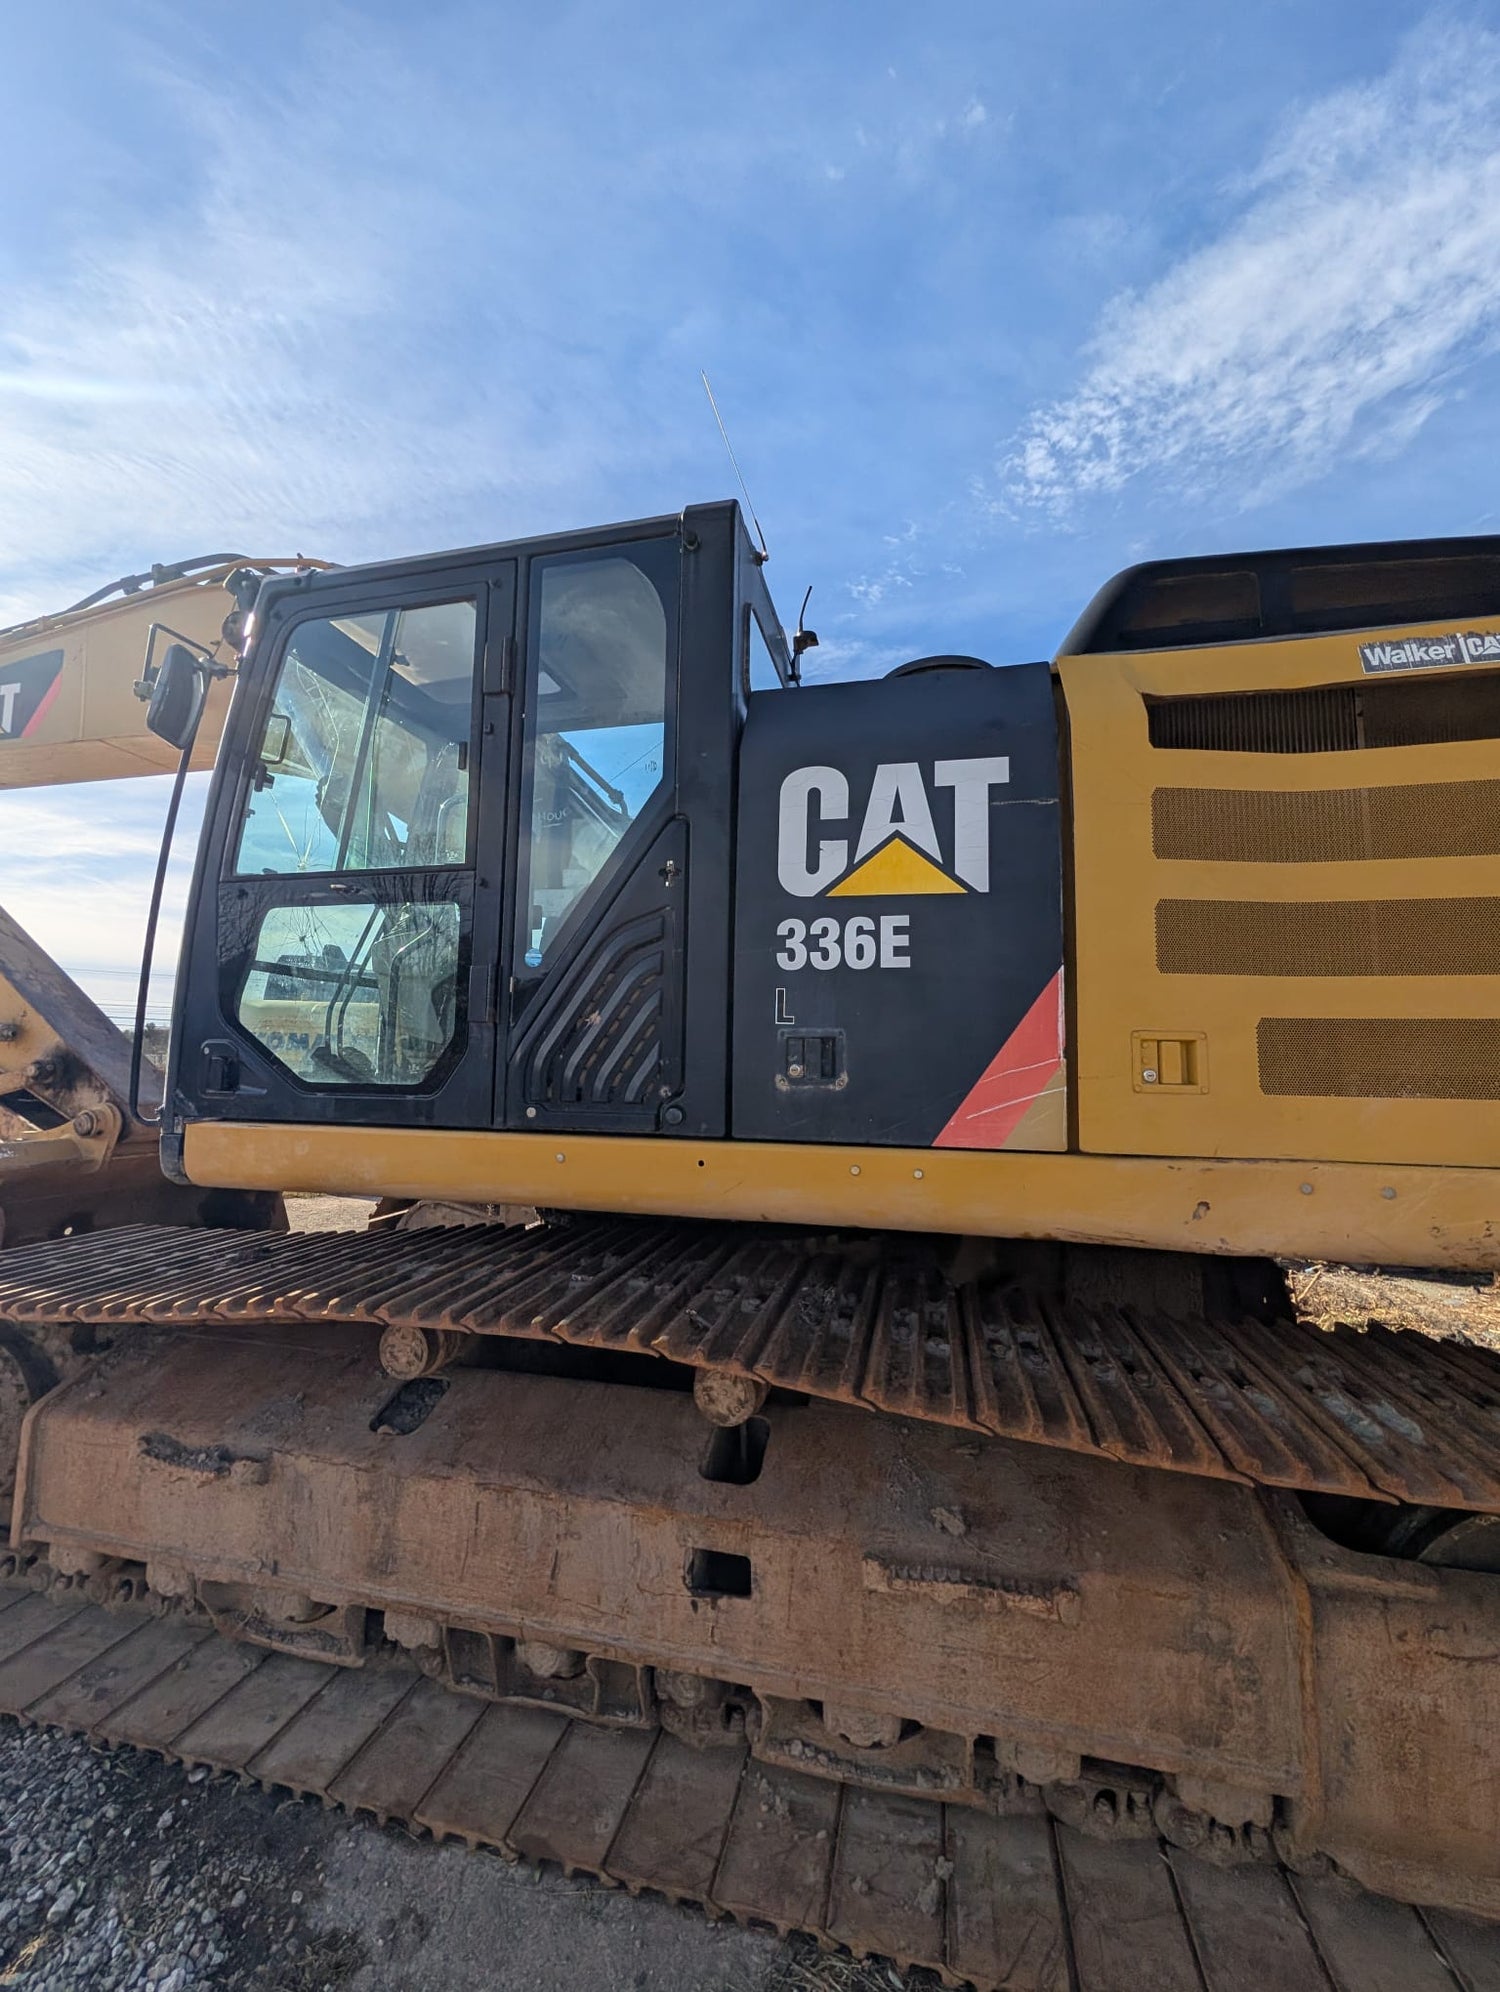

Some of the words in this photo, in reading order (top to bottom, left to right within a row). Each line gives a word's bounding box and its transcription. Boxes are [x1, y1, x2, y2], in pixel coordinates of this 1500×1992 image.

[1364, 643, 1456, 666] Walker
[778, 757, 1009, 897] CAT
[776, 914, 911, 970] 336E
[775, 987, 795, 1024] L
